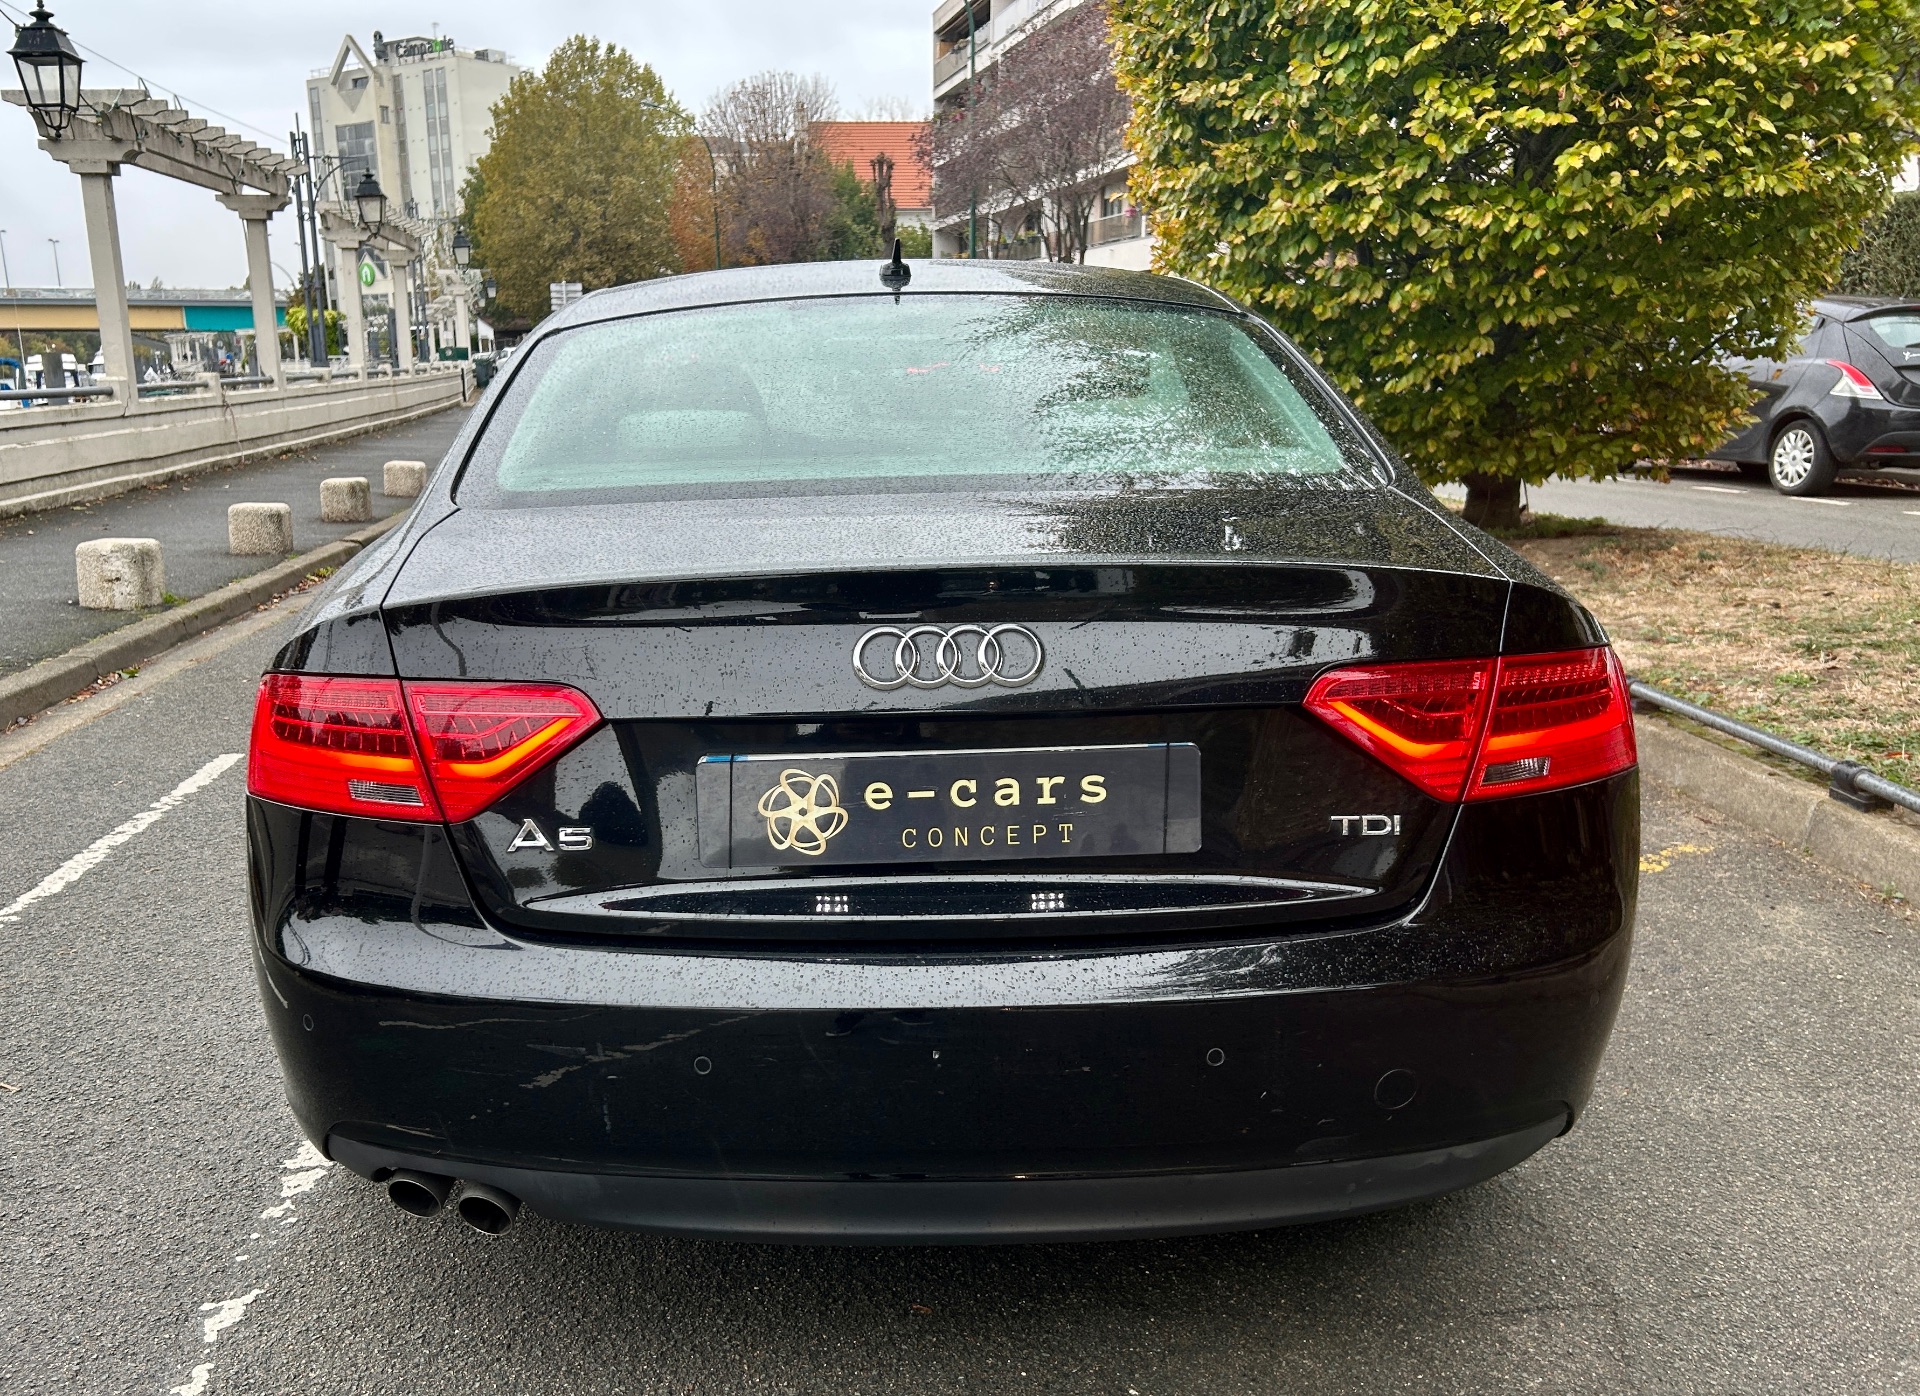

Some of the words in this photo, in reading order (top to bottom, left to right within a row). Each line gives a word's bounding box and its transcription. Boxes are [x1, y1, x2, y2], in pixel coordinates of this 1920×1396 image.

[864, 774, 1107, 811] e-cars
[507, 818, 593, 851] A5
[902, 823, 1073, 848] CONCEPT
[1330, 814, 1401, 836] TDI
